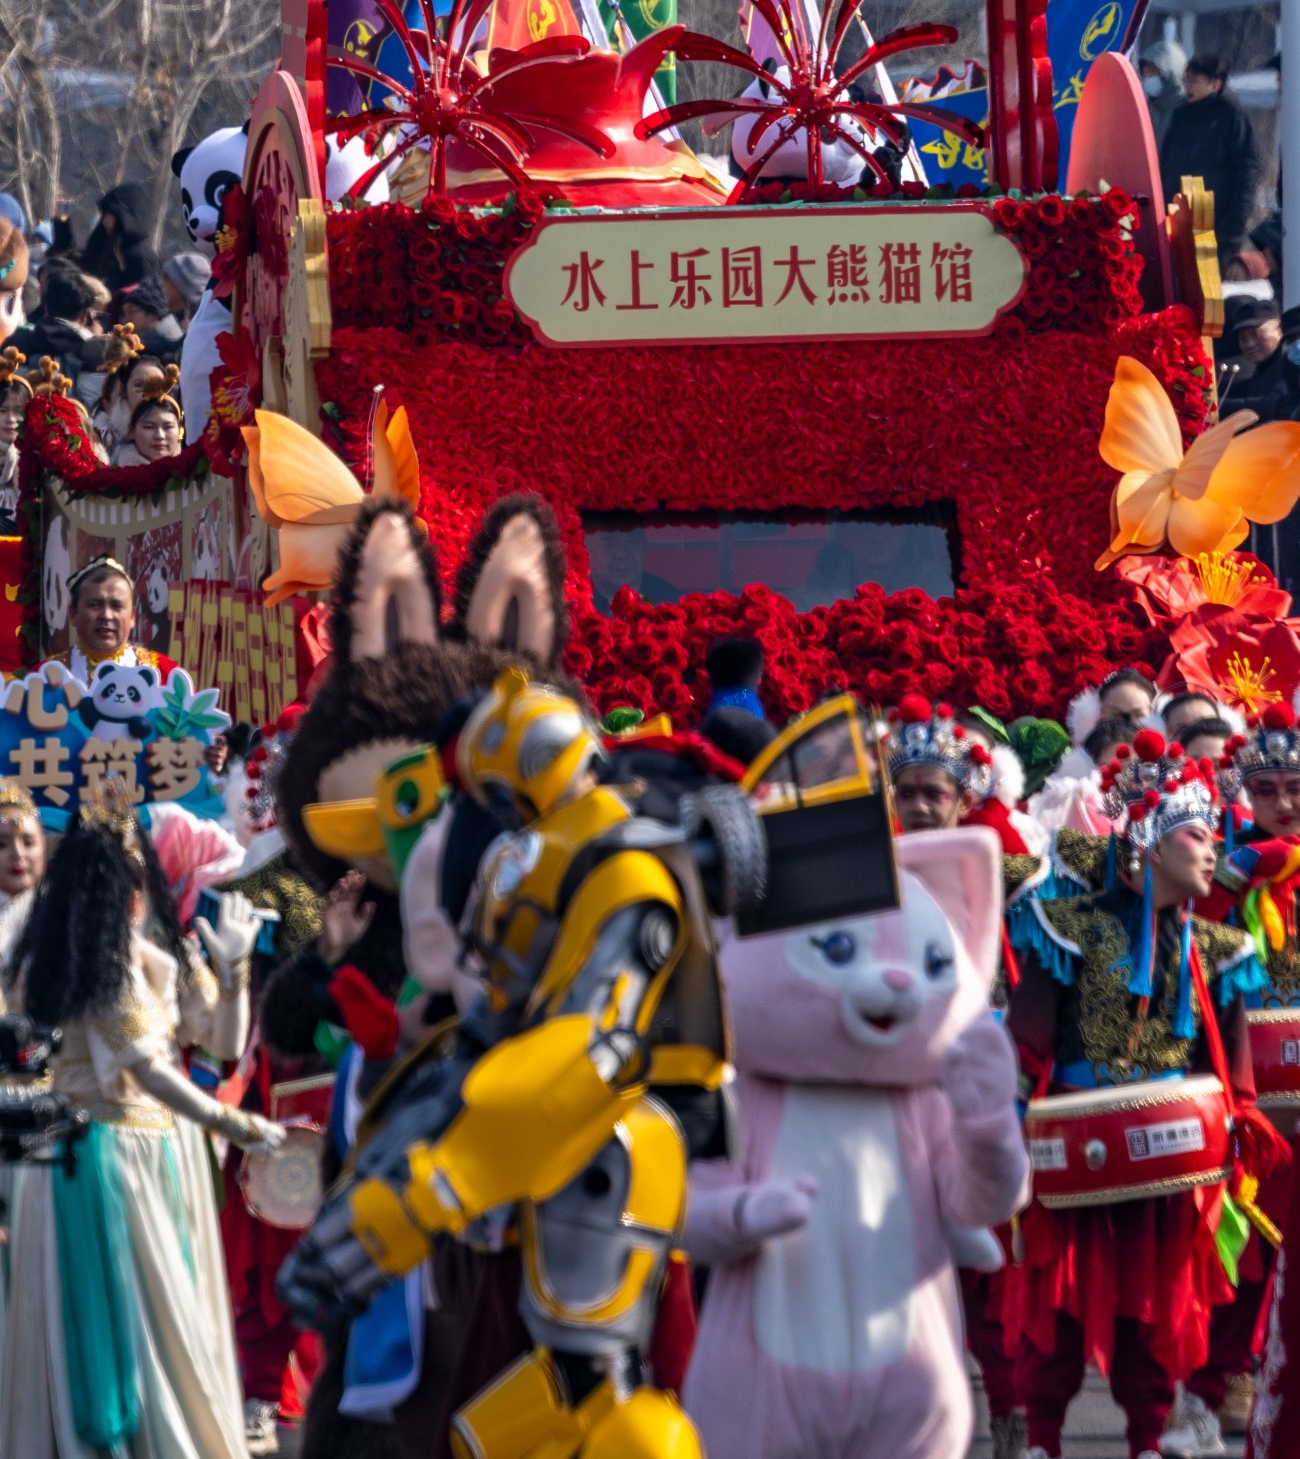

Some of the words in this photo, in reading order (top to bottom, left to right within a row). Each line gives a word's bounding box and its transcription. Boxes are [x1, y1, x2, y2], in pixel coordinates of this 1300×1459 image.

[560, 241, 974, 313] 水上乐园大熊猫馆
[6, 736, 205, 807] 共筑梦
